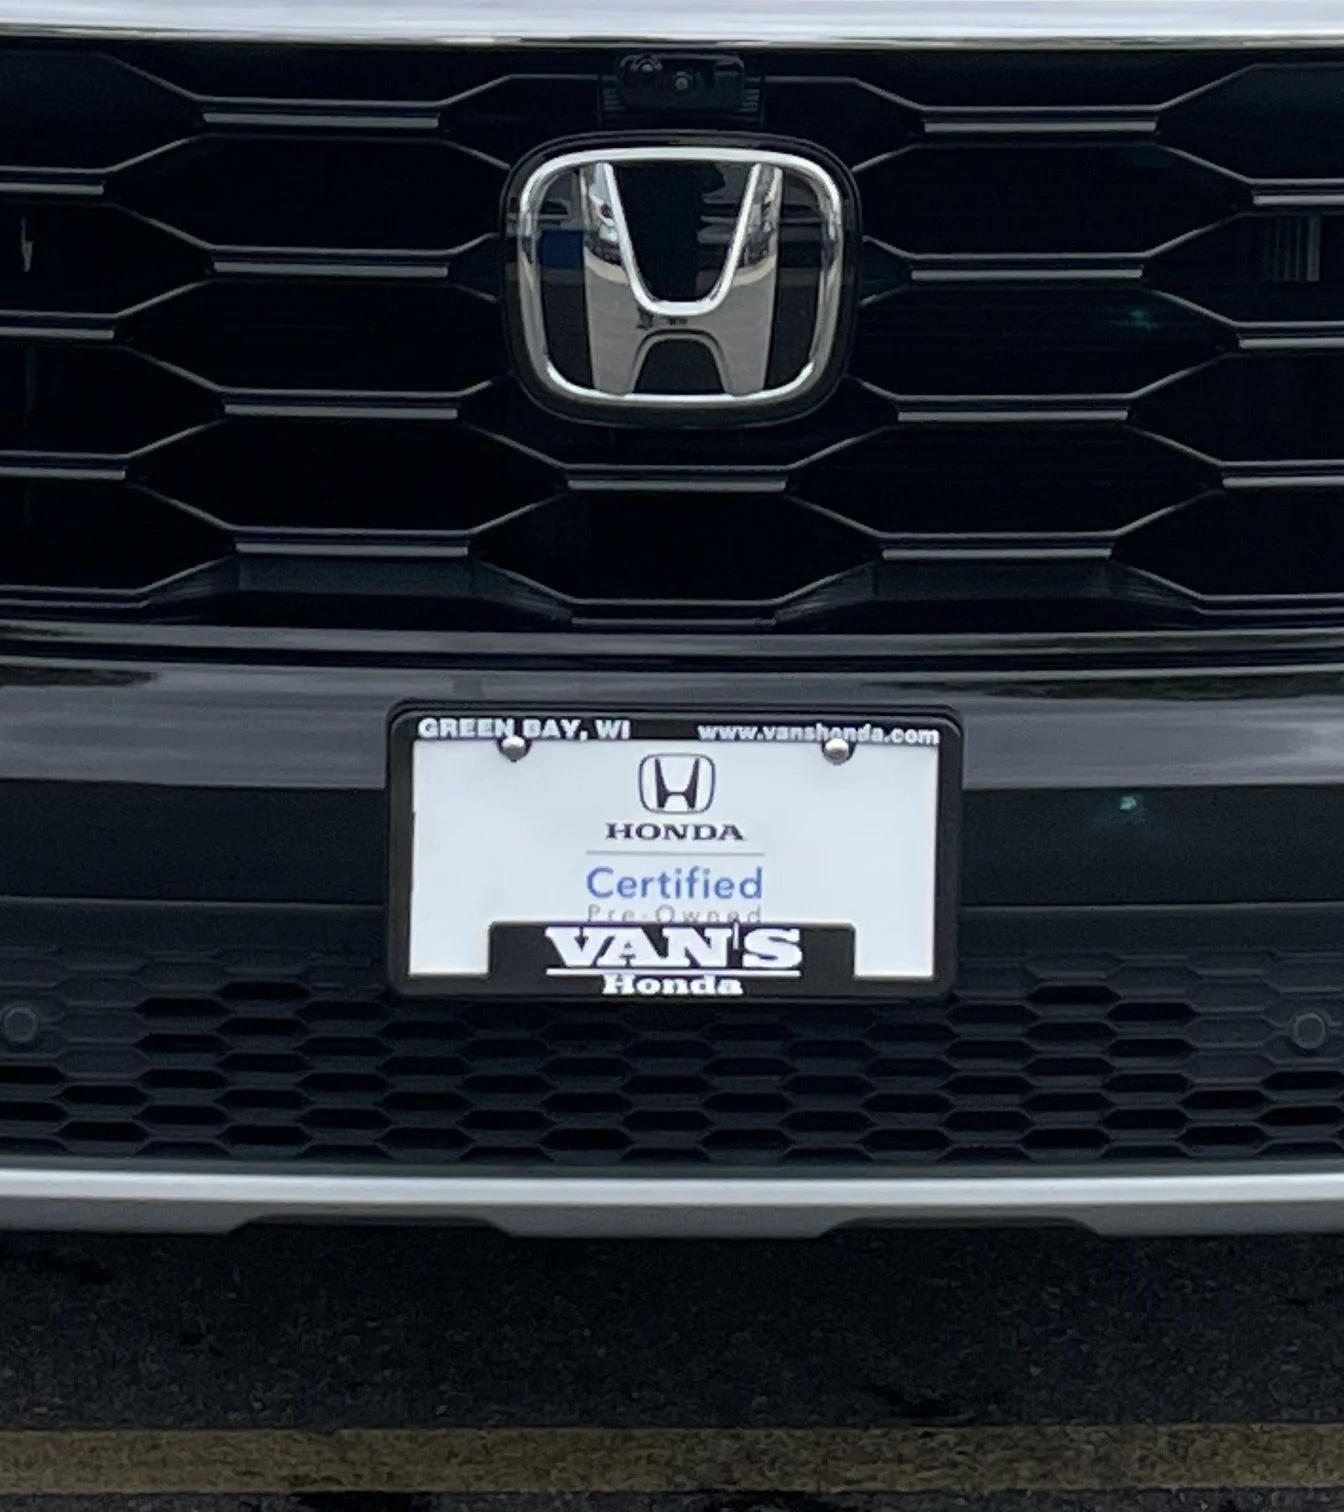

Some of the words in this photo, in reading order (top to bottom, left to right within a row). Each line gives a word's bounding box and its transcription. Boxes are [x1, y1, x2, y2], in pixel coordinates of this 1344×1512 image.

[417, 717, 515, 740] GREEN
[521, 718, 589, 741] BAY,
[596, 720, 631, 739] WI
[697, 722, 941, 745] www.vanshonda.com
[605, 822, 744, 841] HONDA
[586, 866, 763, 900] Certified
[544, 921, 803, 969] VAN'S
[602, 973, 744, 996] Honda
